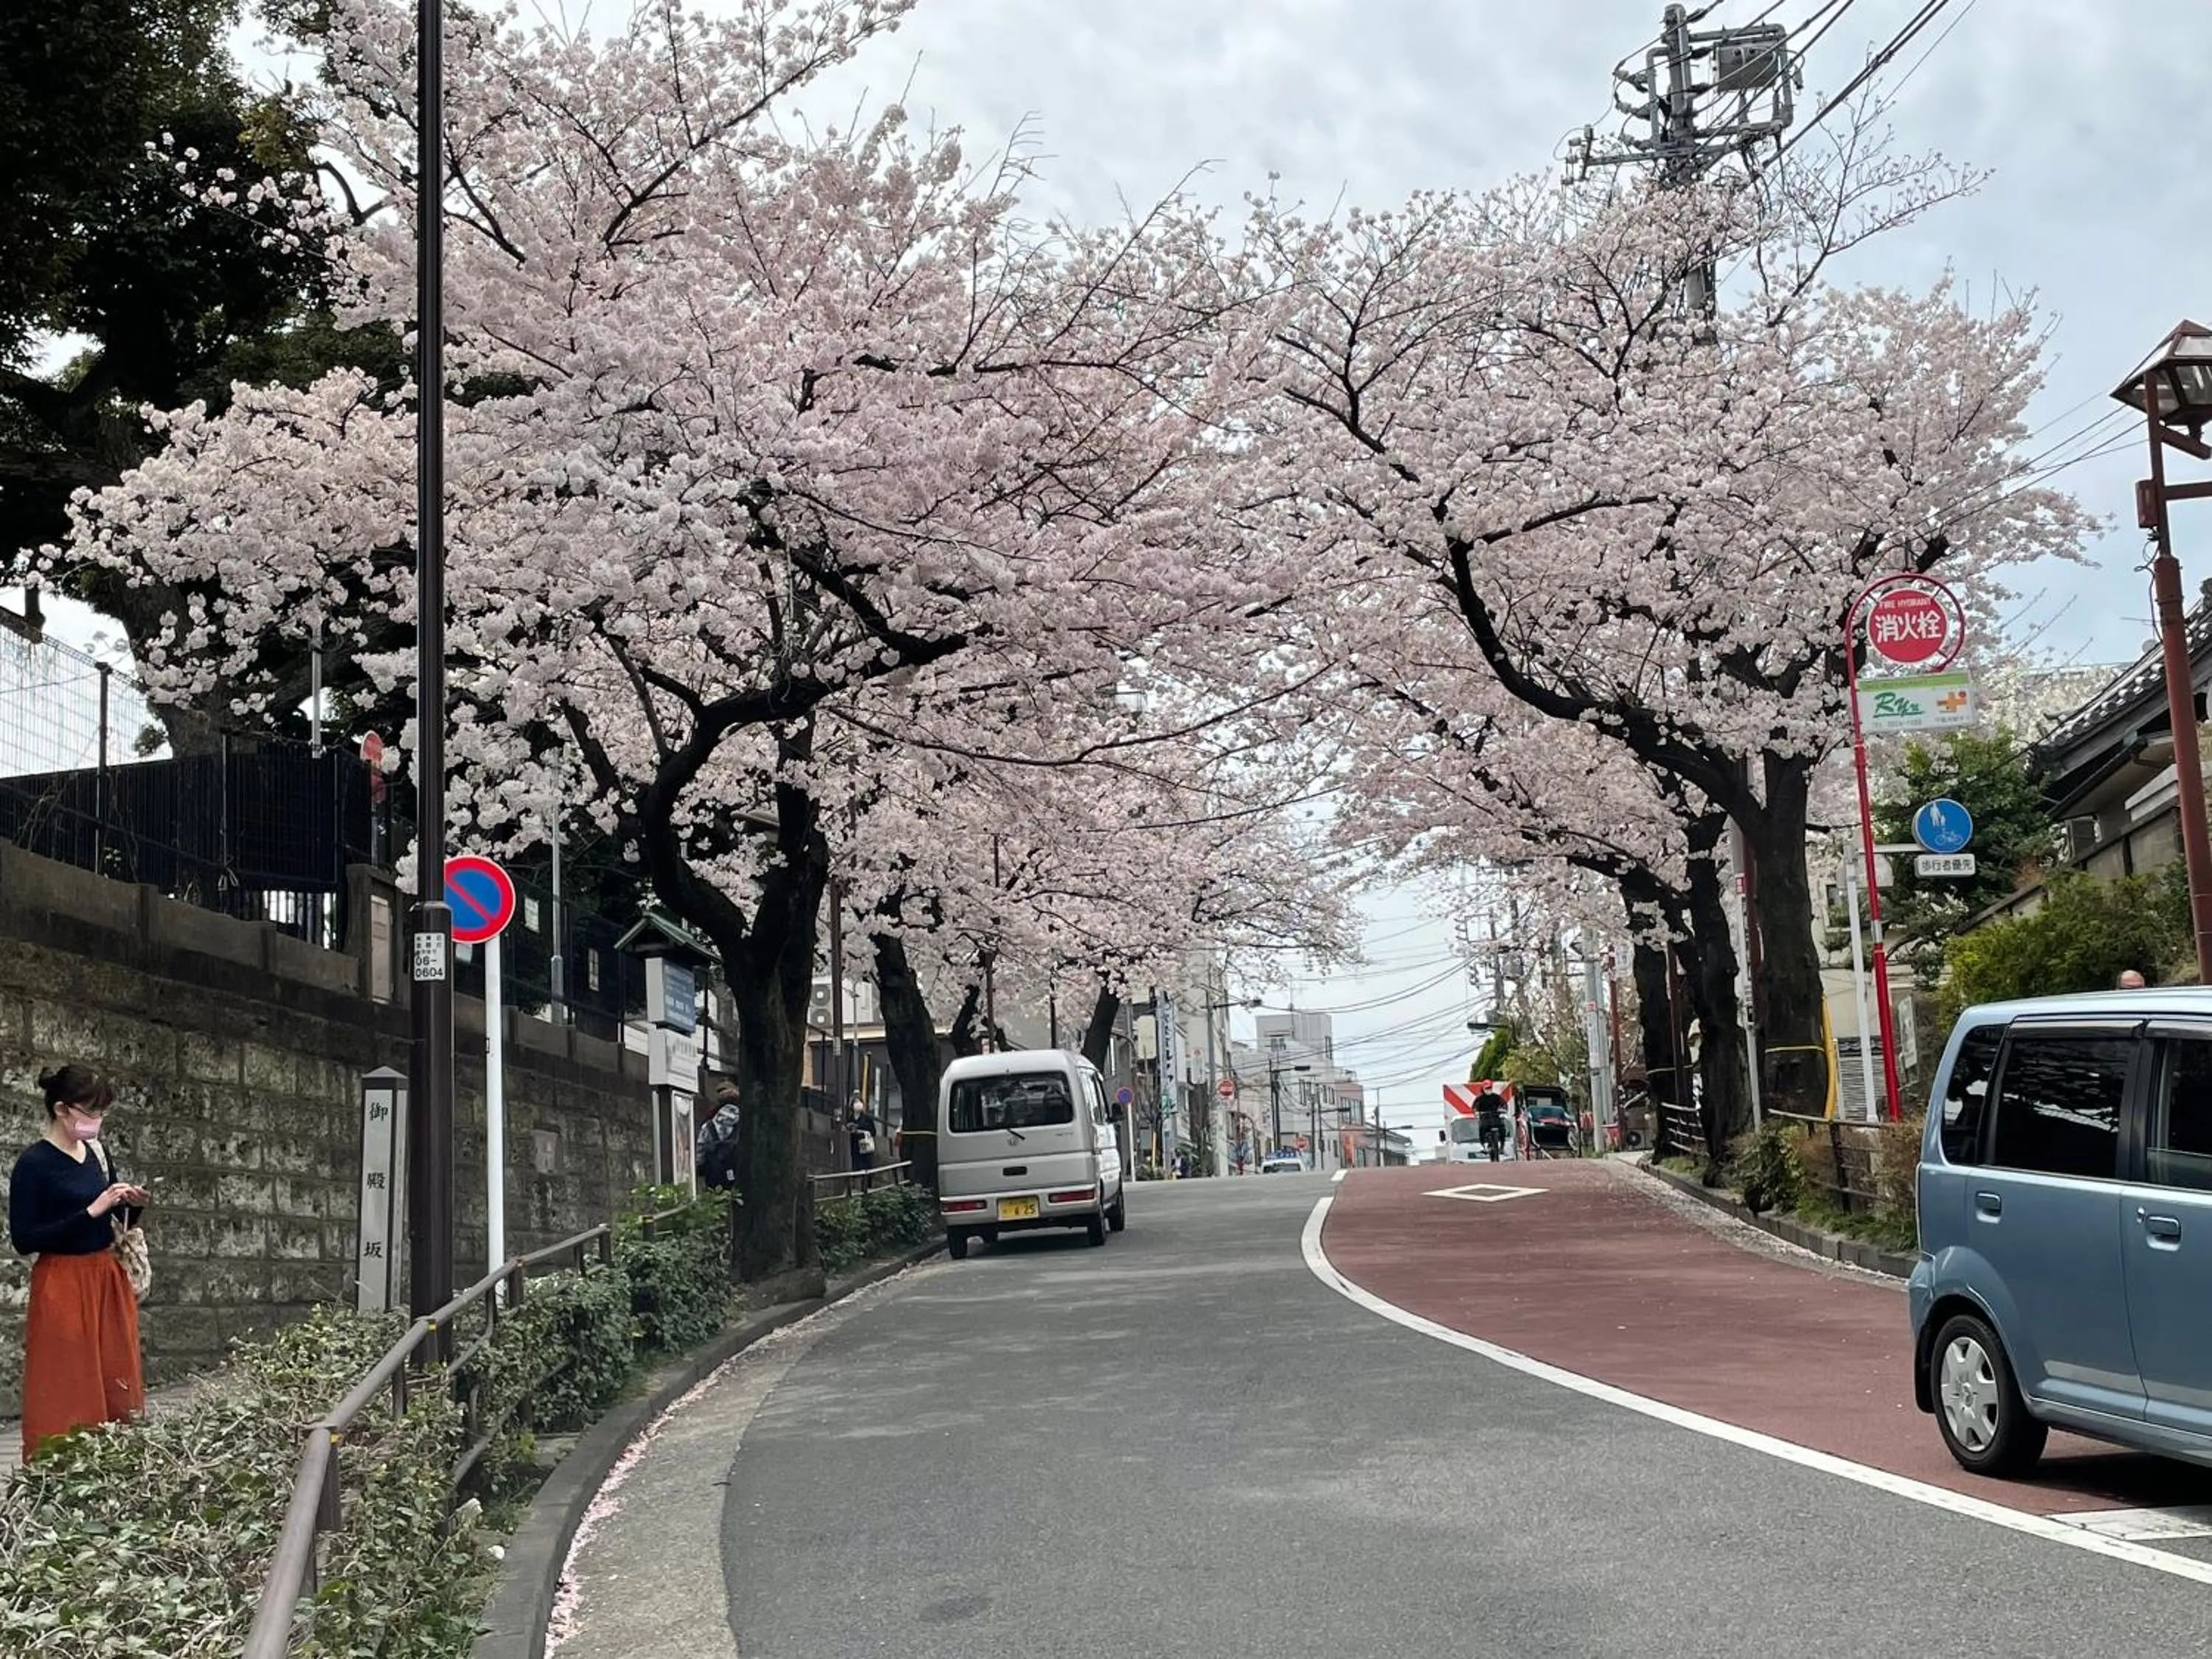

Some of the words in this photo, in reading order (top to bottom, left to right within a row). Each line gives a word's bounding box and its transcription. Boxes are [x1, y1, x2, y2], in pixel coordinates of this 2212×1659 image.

[1875, 610, 1942, 643] 消火栓
[1921, 859, 1973, 871] 歩行者優先
[415, 967, 443, 978] 0604
[364, 1102, 389, 1259] 御殿坂
